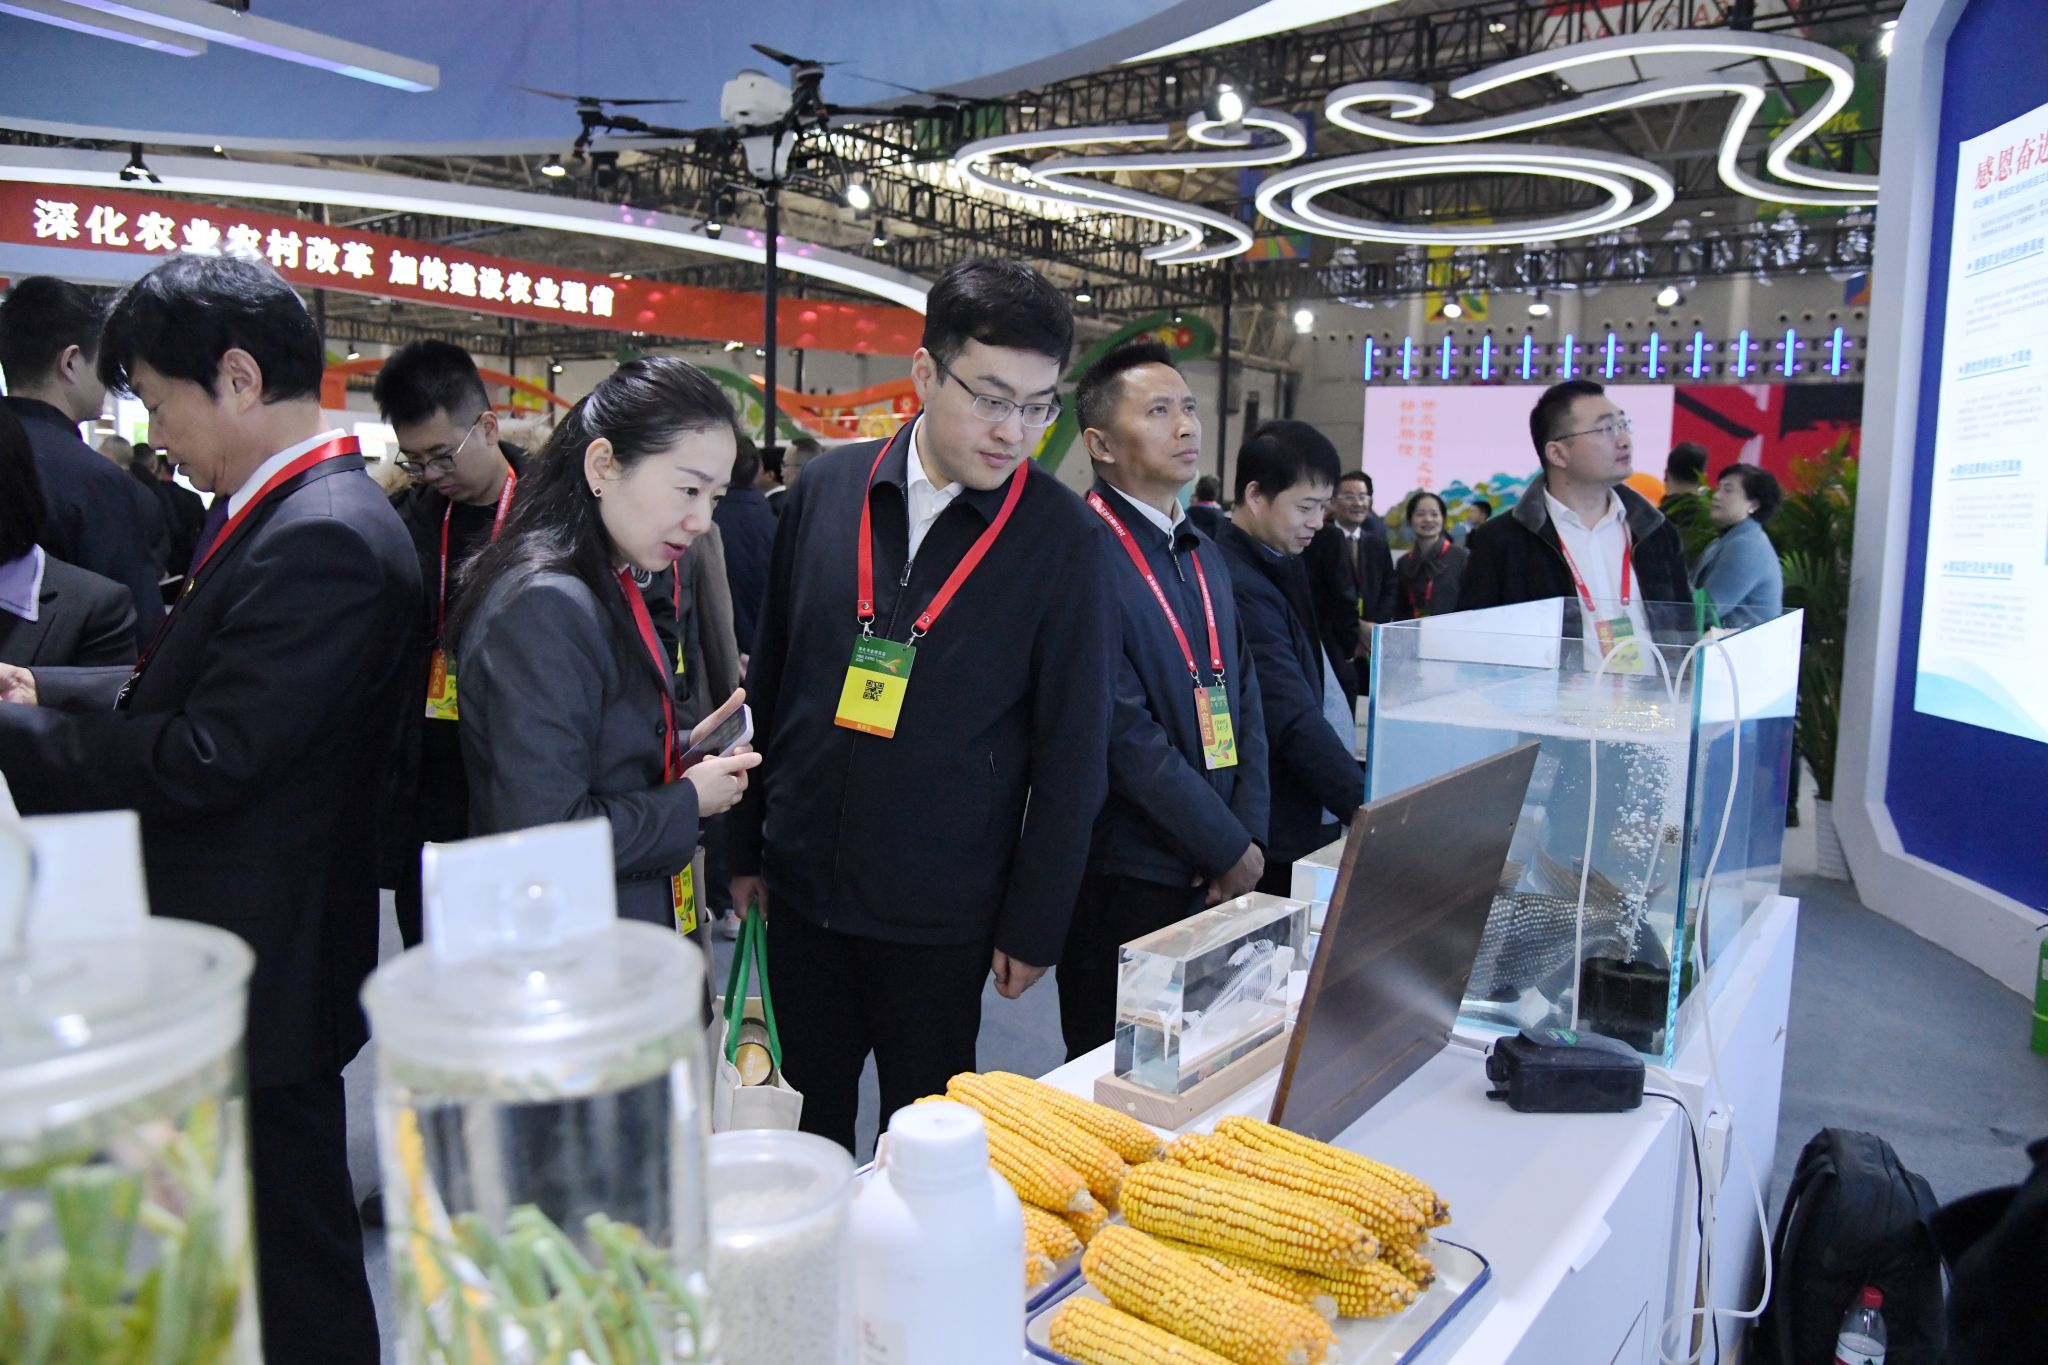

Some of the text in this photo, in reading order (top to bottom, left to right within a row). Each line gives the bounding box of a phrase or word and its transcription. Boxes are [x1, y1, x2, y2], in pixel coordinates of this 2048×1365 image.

[33, 198, 615, 318] 深化农业农村改革 加快建设农业强省
